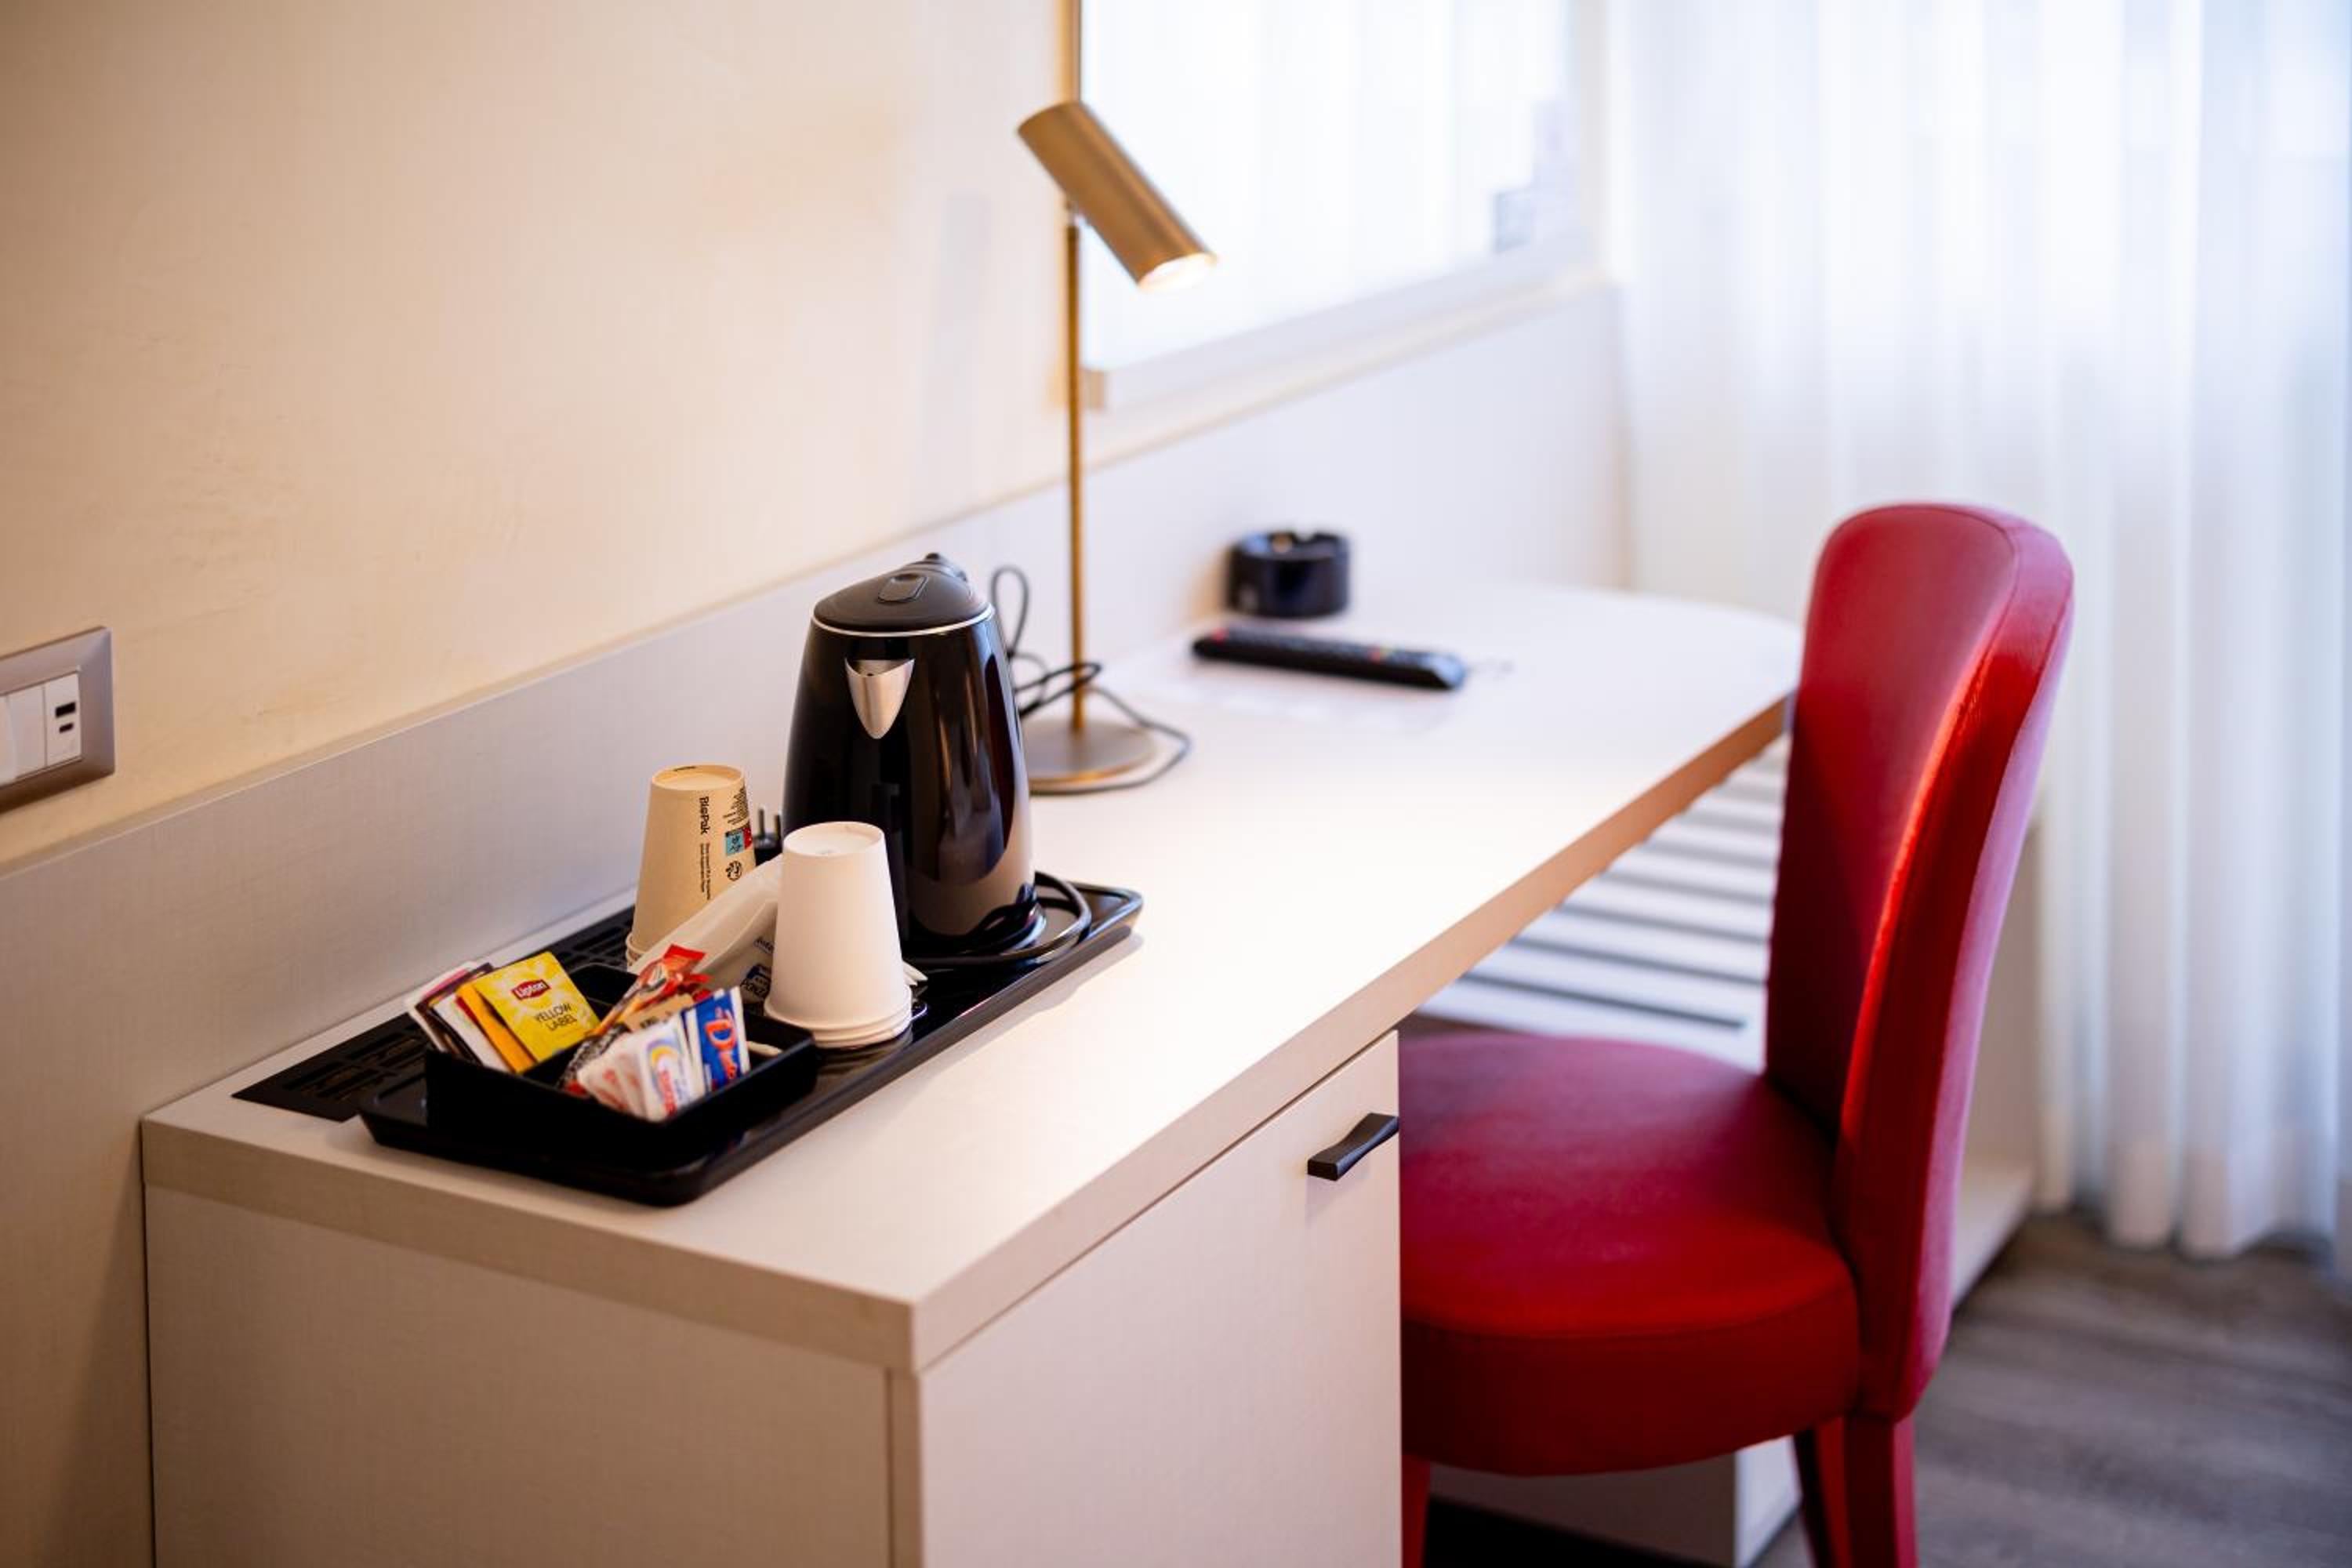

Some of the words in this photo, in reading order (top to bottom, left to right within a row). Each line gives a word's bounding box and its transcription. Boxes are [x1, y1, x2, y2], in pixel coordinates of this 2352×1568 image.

[699, 796, 710, 834] BioPak
[514, 981, 548, 998] Lipton
[535, 1003, 571, 1022] YELLOW
[546, 1014, 577, 1031] LABEL
